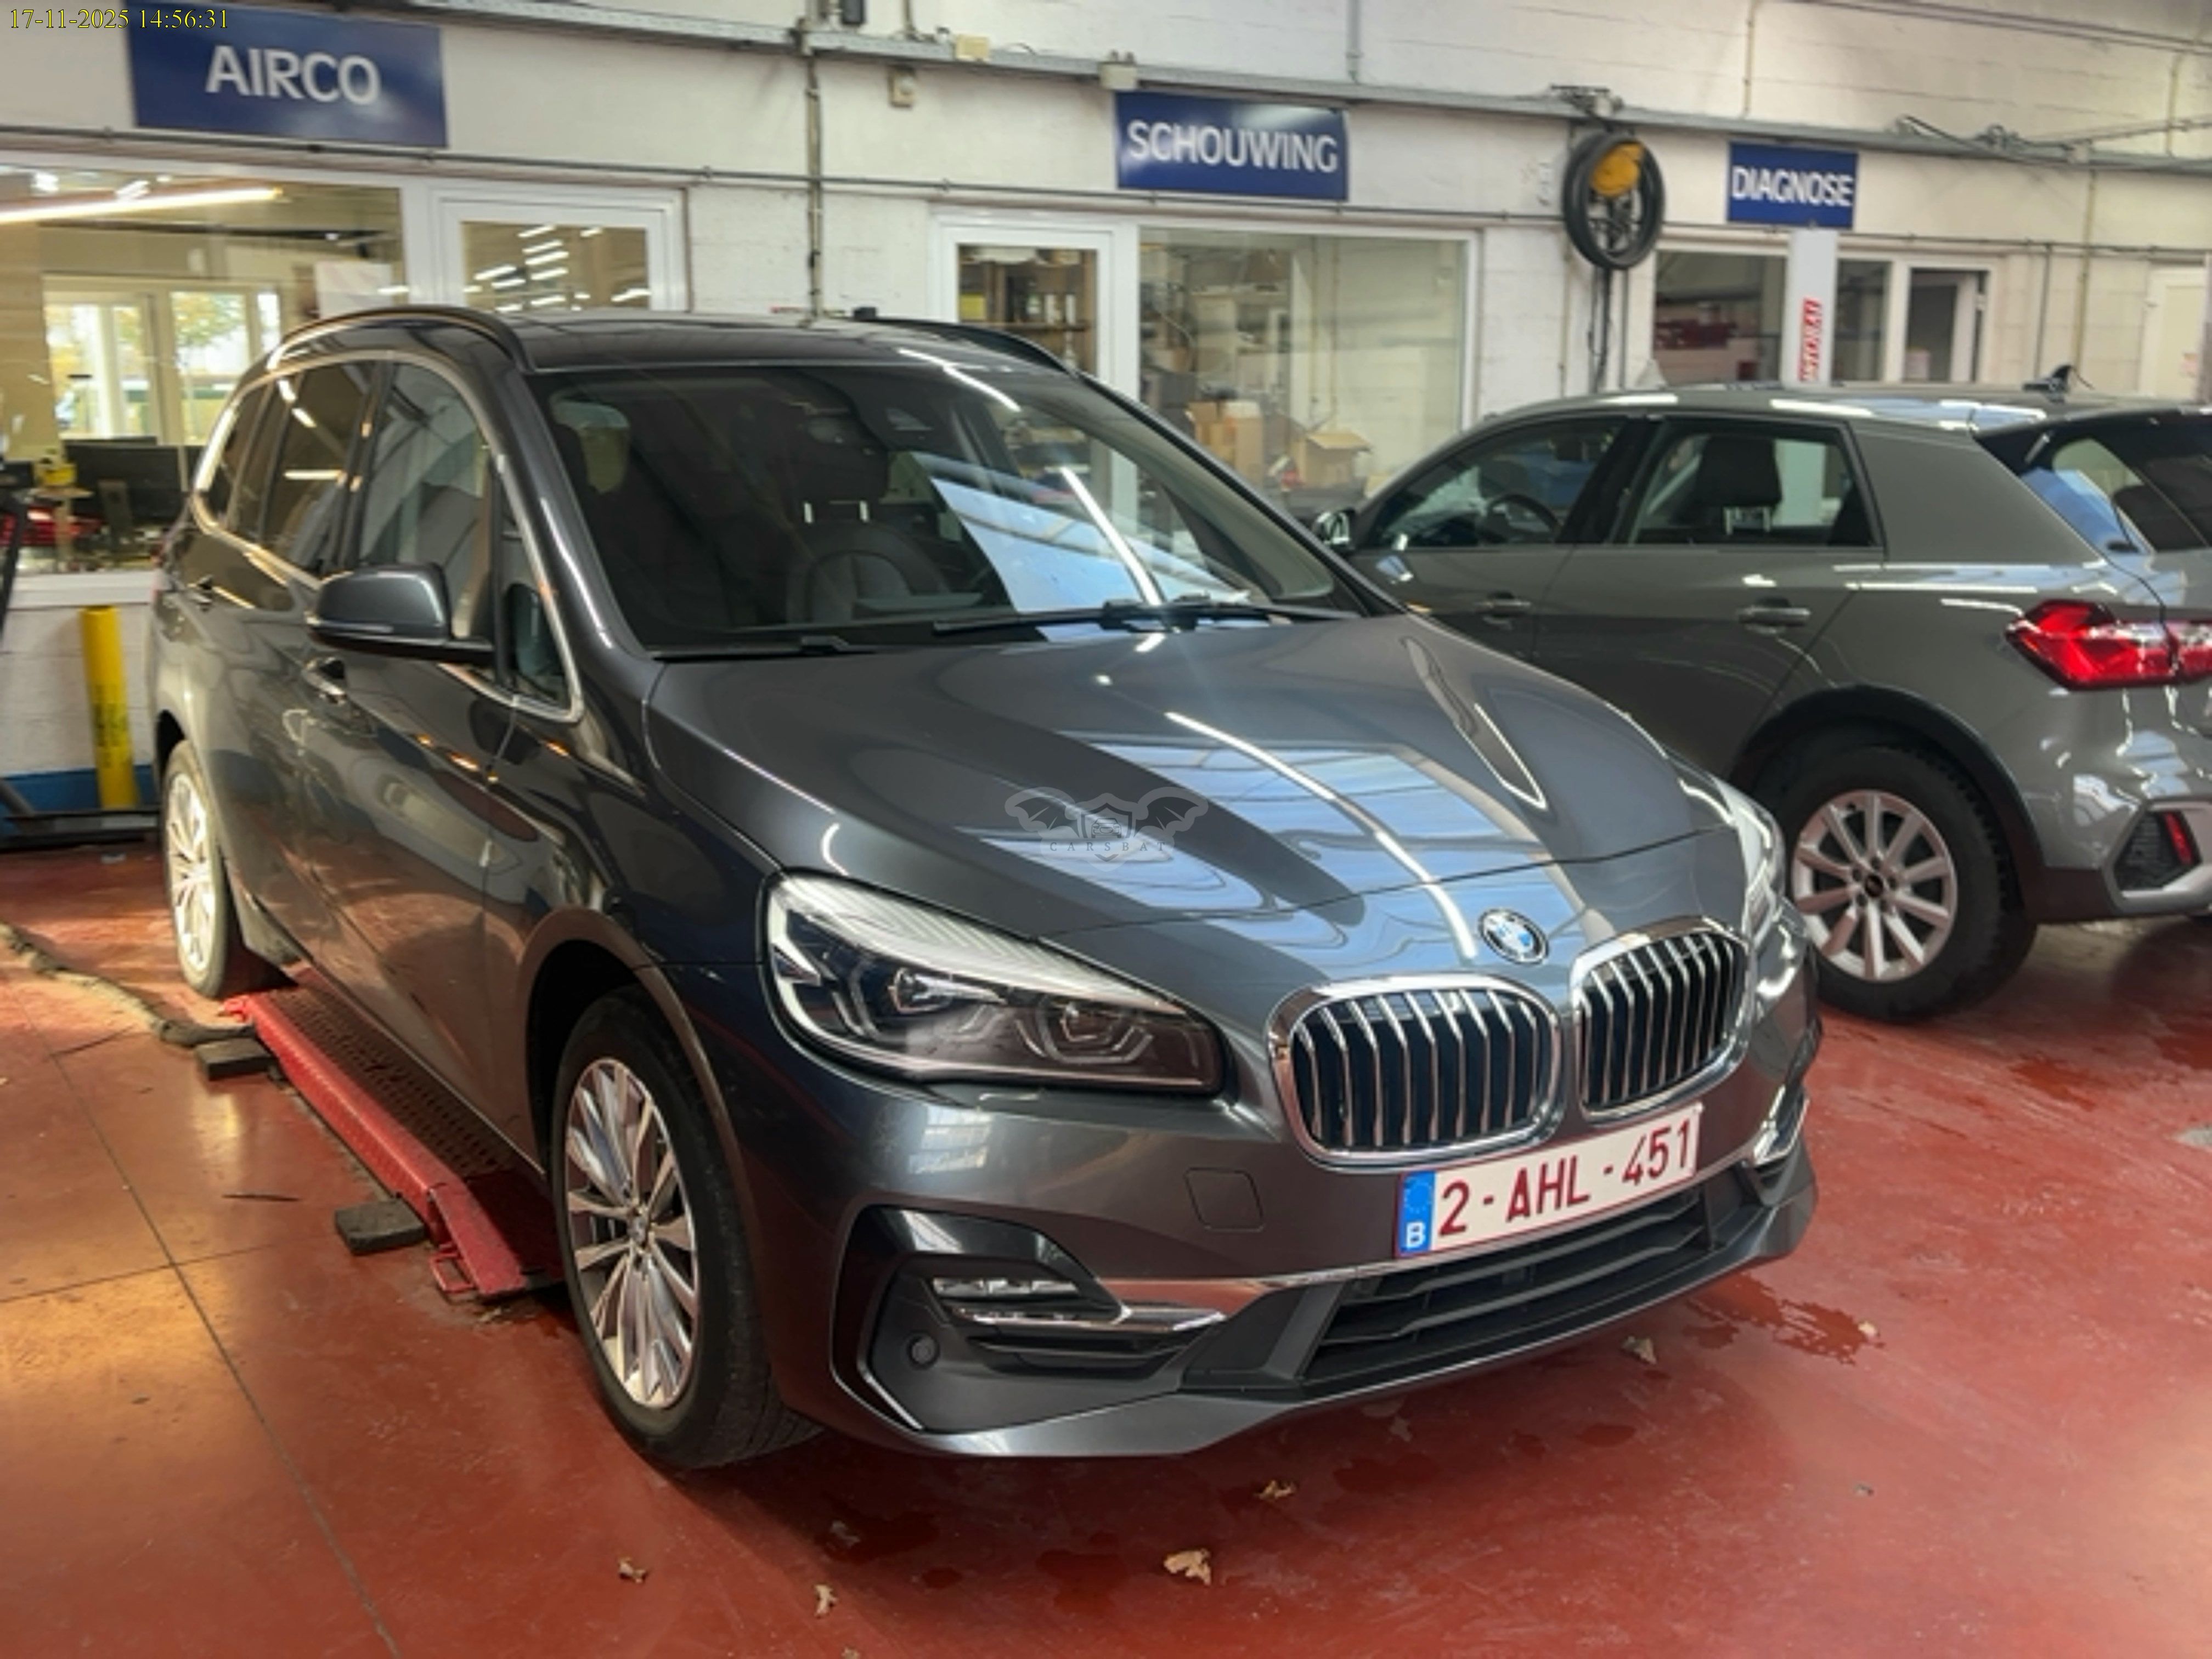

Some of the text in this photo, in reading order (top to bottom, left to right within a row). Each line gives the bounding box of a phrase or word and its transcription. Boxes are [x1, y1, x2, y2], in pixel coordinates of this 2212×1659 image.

[205, 44, 382, 106] AIRCO
[1127, 119, 1338, 173] SCHOUWING
[1731, 166, 1854, 207] DIAGNOSE
[1406, 1221, 1425, 1249] B
